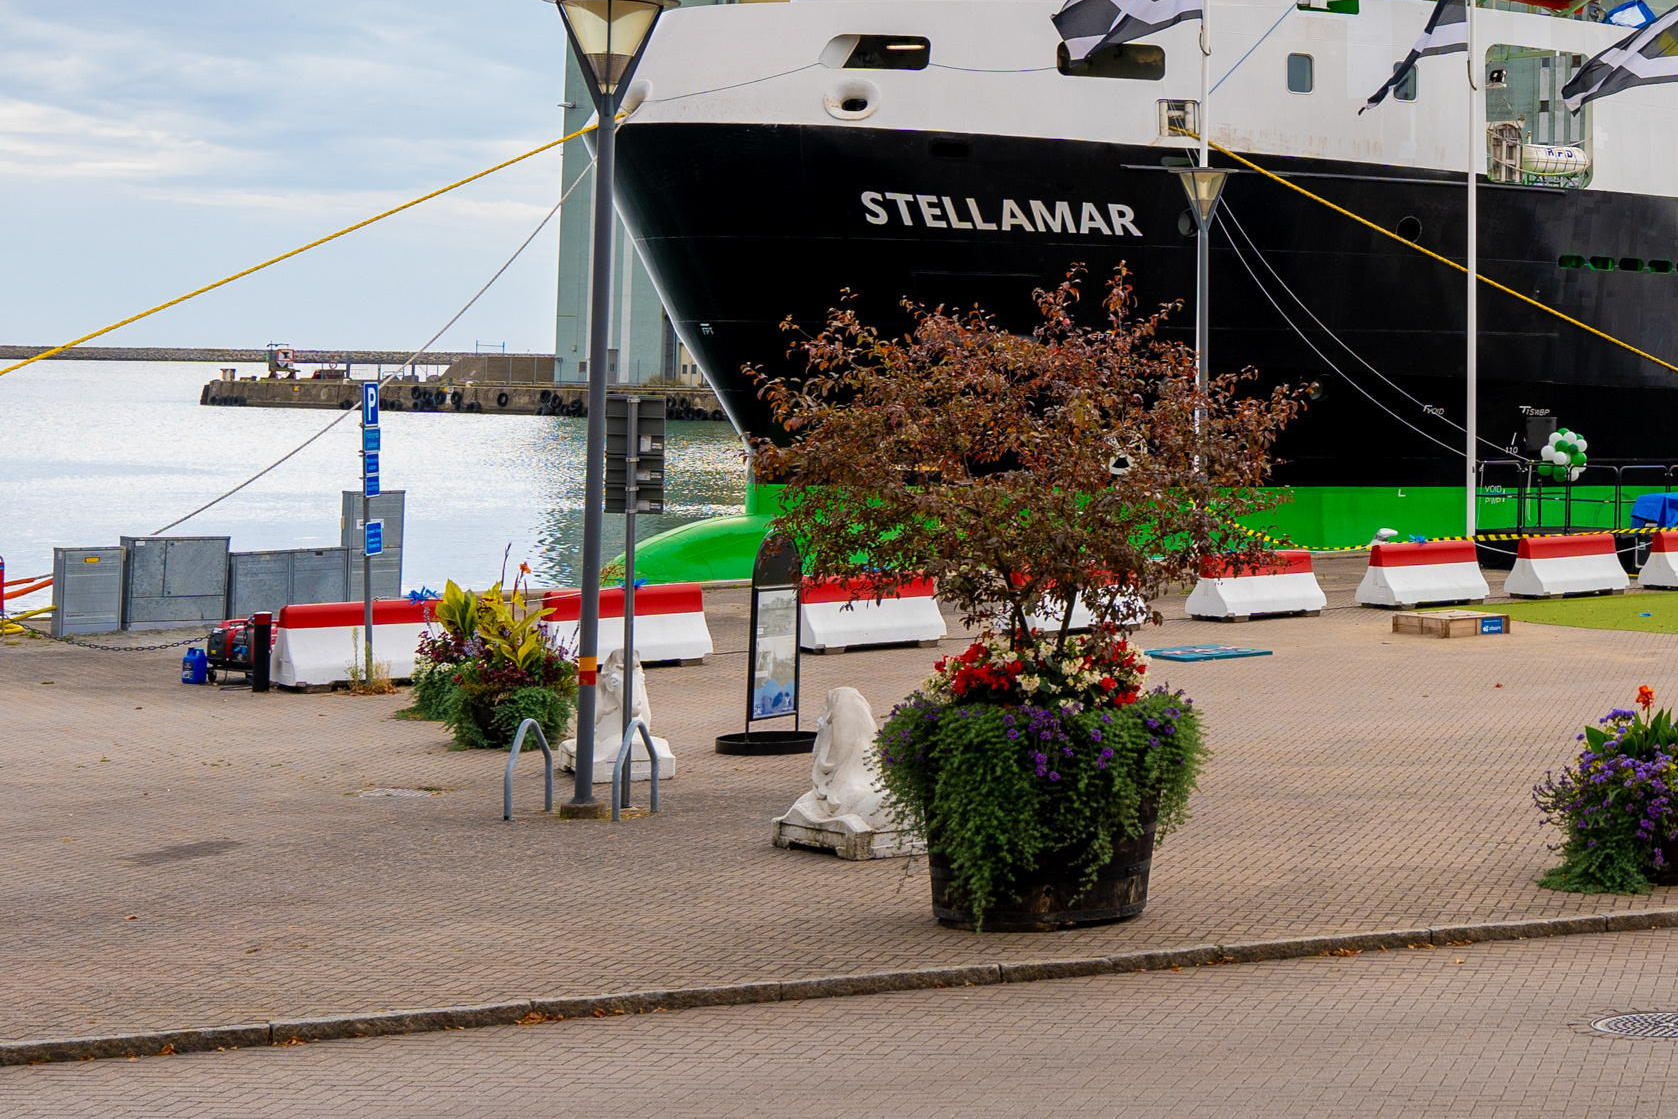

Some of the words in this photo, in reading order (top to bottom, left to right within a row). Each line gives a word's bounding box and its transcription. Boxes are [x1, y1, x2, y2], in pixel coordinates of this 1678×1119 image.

[861, 191, 1143, 236] STELLAMAR
[367, 387, 376, 421] P
[1485, 485, 1502, 493] VOID
